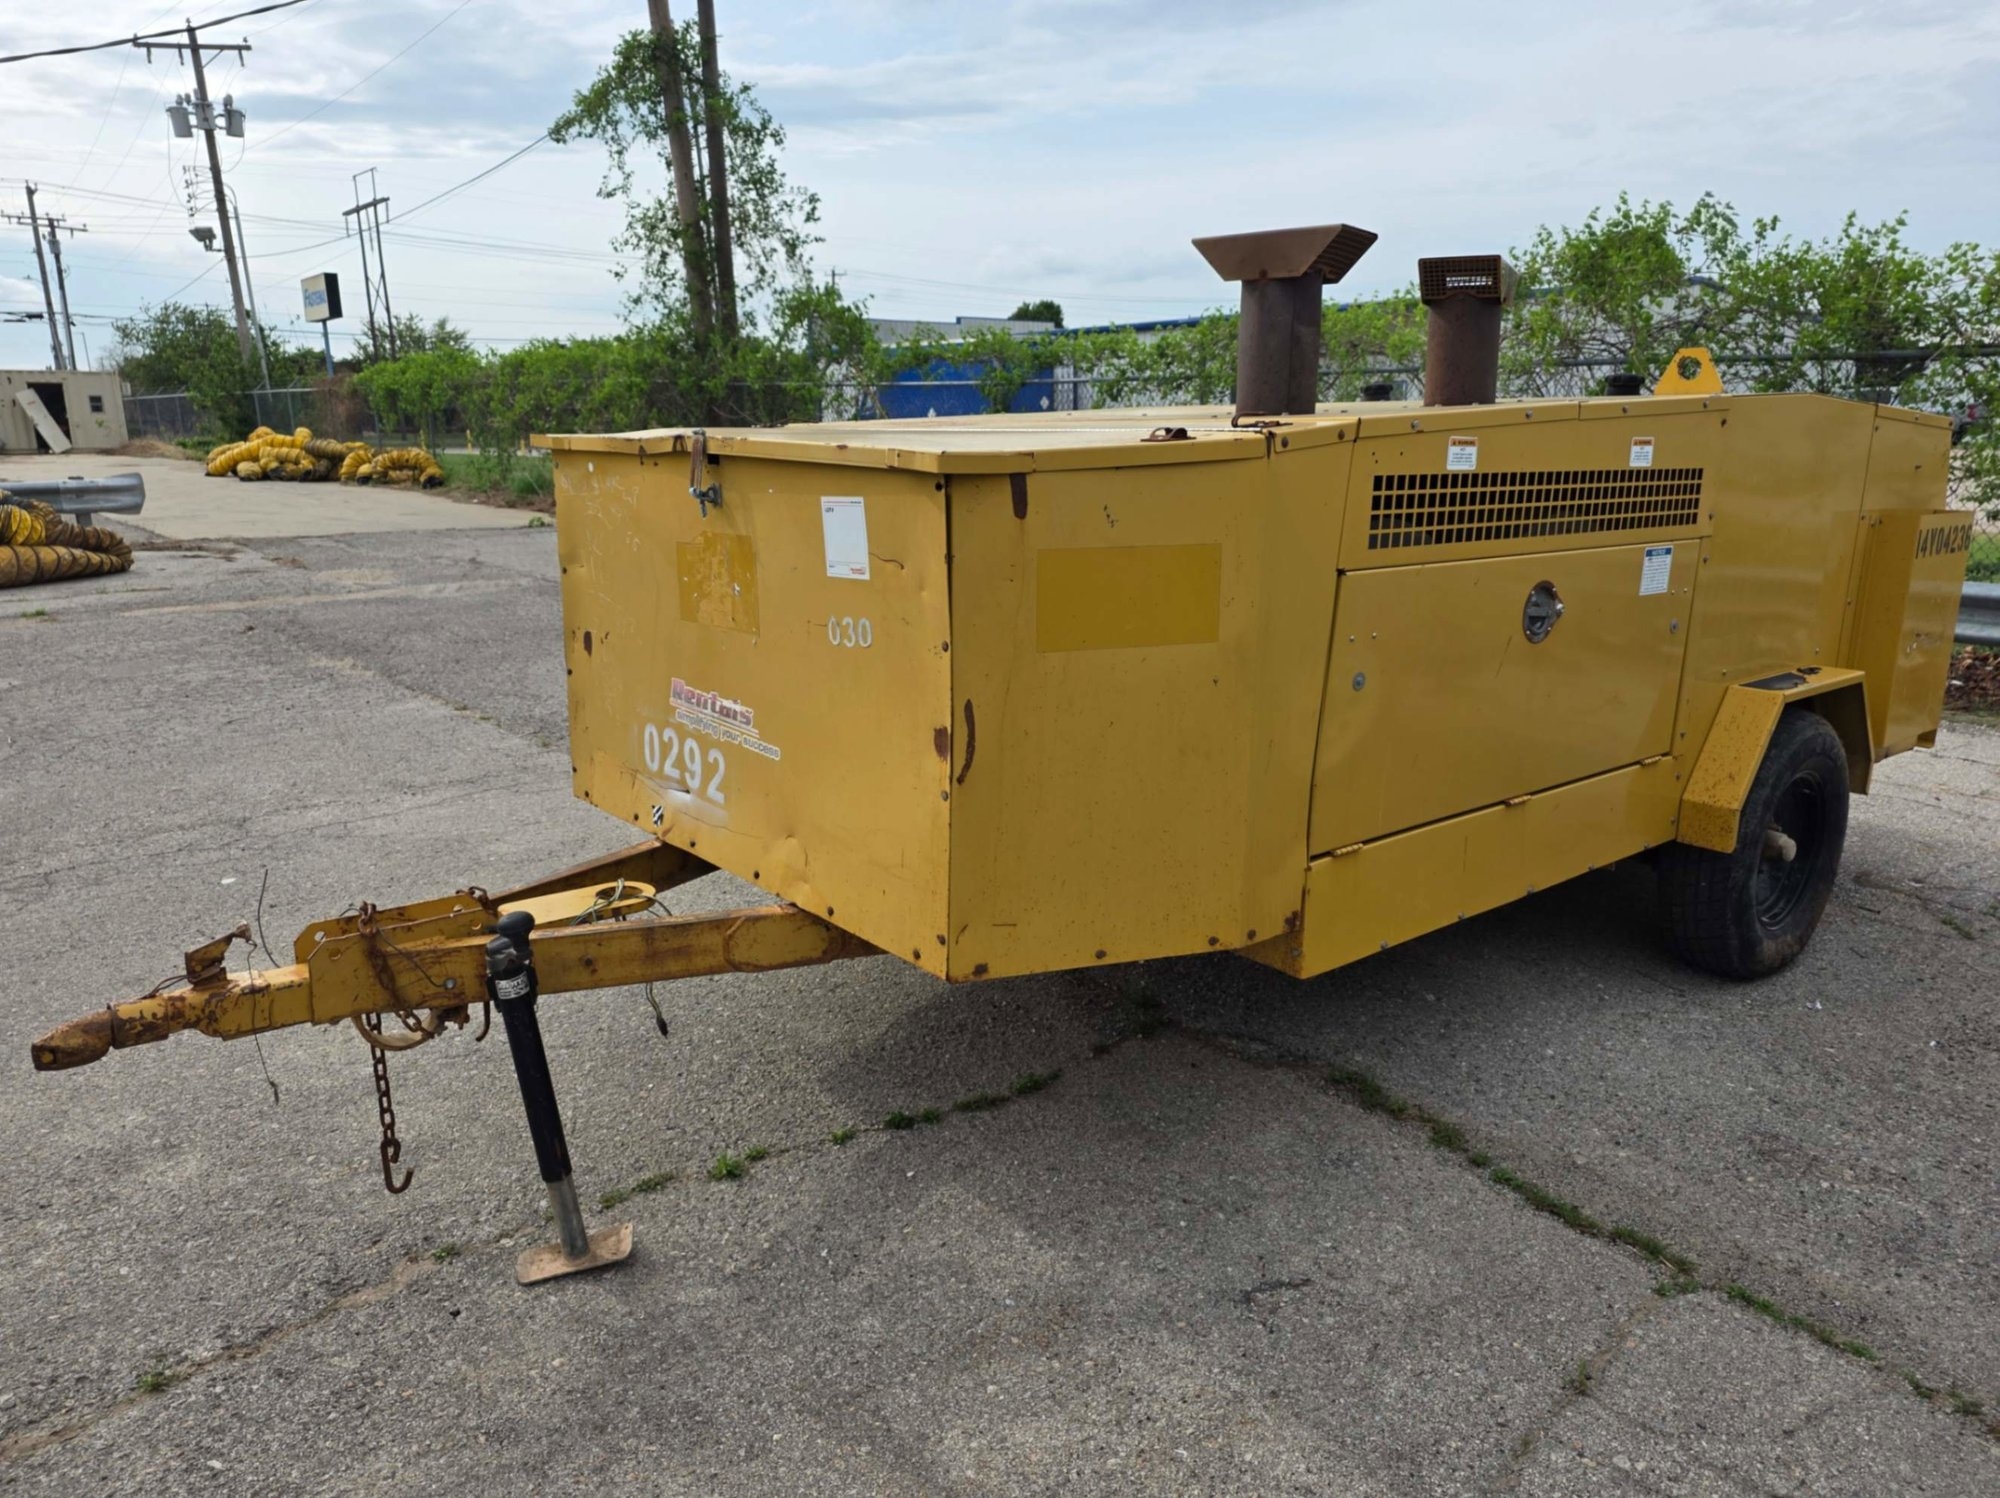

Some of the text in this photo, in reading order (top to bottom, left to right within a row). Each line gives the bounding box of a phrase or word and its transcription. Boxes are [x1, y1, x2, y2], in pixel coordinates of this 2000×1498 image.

[828, 616, 872, 648] 030
[677, 711, 780, 760] simplifying your success
[643, 724, 726, 803] 0292
